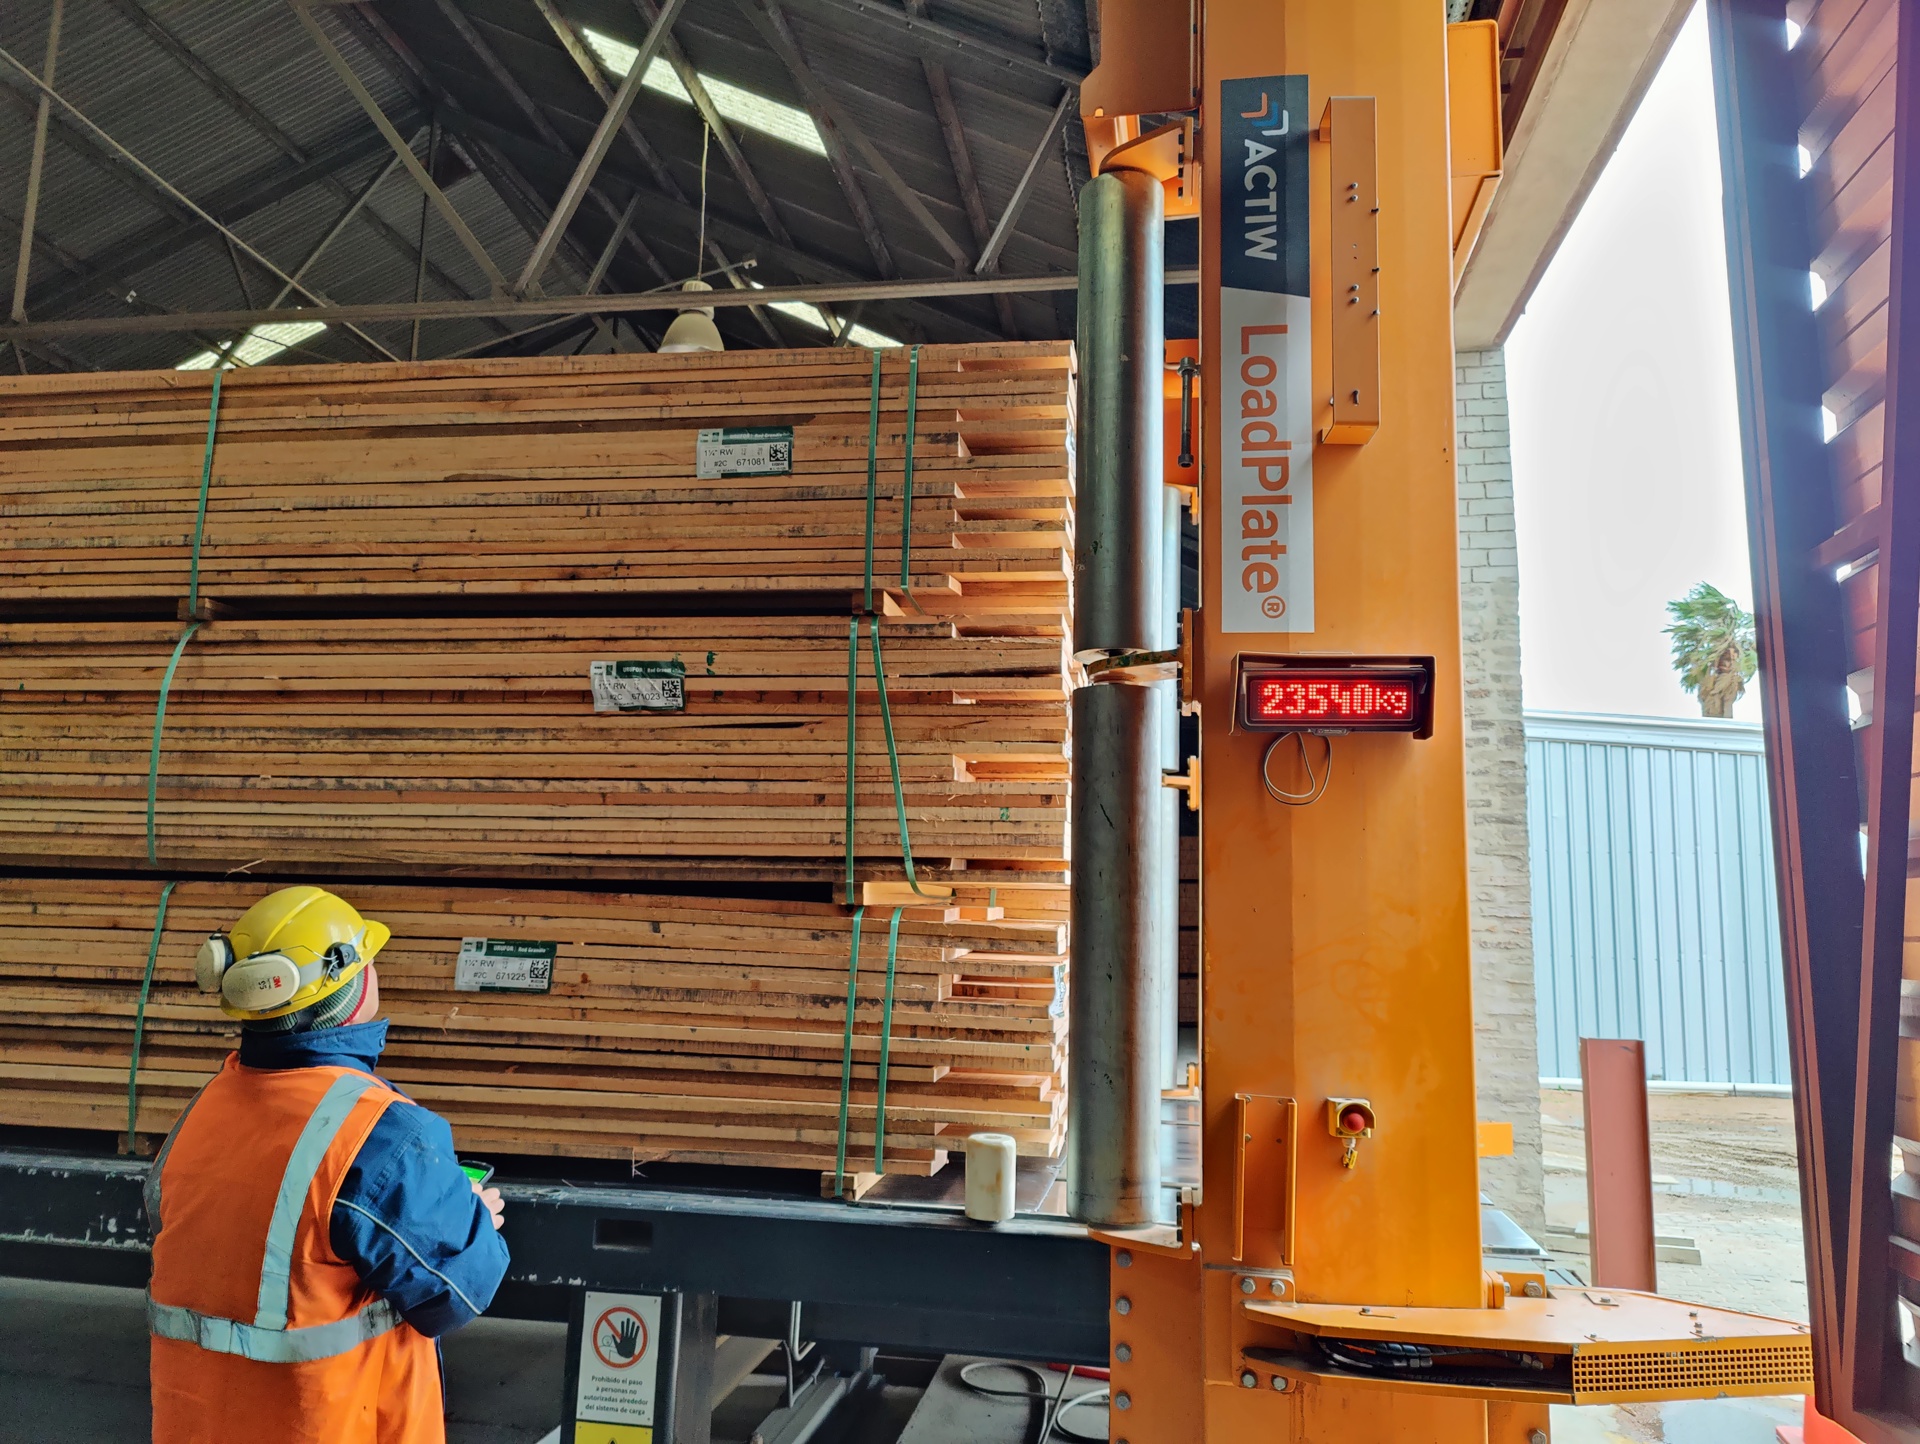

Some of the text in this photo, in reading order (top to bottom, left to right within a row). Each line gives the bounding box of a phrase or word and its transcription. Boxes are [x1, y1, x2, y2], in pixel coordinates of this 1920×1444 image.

[1244, 138, 1278, 261] ACTIW
[719, 448, 734, 456] RW
[713, 460, 728, 468] #2C
[736, 457, 766, 467] 671081
[613, 682, 627, 690] RW
[631, 692, 661, 701] 671023
[1263, 684, 1407, 714] 23540kg
[480, 959, 495, 968] RW
[473, 971, 487, 979] #2C
[495, 971, 527, 981] 671225
[273, 976, 282, 988] 3M
[592, 1375, 620, 1383] Prohibido
[619, 1397, 648, 1405] alrededor
[595, 1404, 619, 1412] sistema
